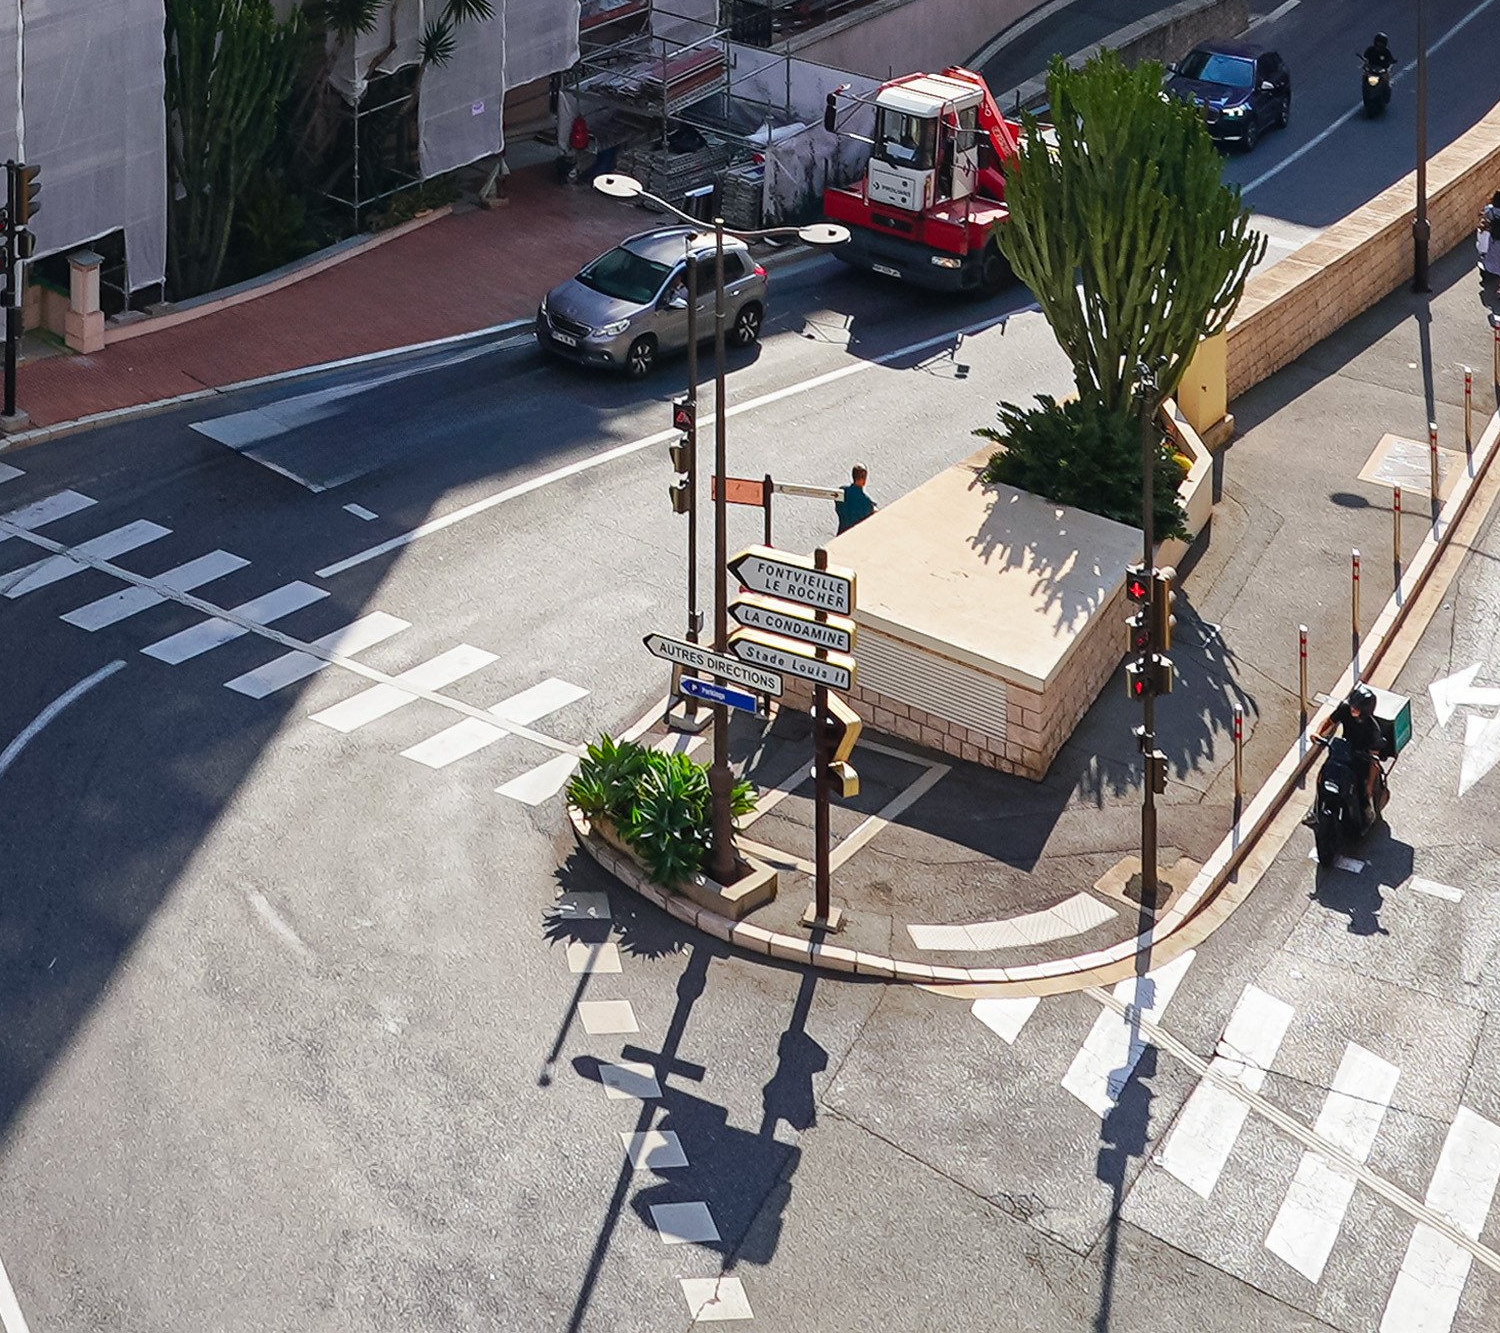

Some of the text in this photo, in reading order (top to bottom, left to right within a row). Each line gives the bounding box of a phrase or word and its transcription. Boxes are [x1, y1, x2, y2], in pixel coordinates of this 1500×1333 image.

[757, 562, 844, 595] FONTVIEILLE
[765, 578, 845, 608] LE ROCHER
[744, 609, 845, 646] LA CONDAMINE
[659, 642, 776, 690] AUTRES DIRECTIONS
[746, 646, 846, 684] Stade Louis II
[701, 686, 726, 701] Parkings
